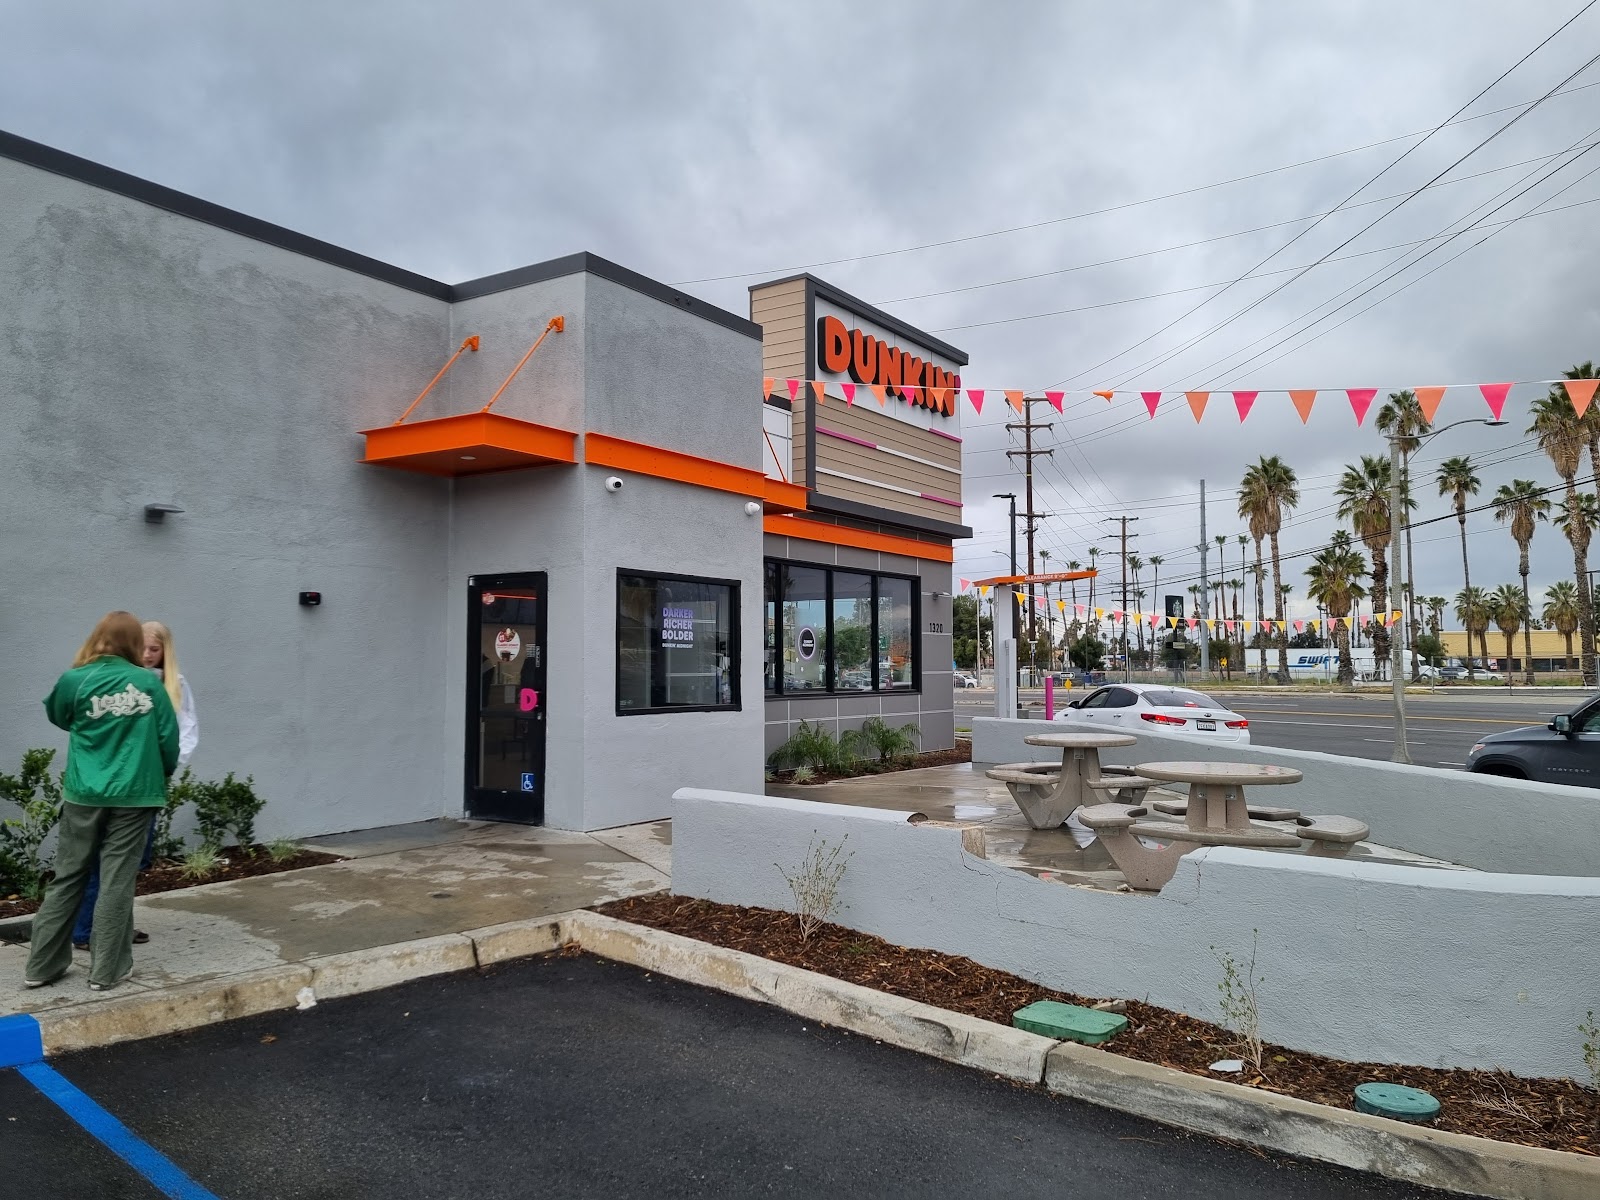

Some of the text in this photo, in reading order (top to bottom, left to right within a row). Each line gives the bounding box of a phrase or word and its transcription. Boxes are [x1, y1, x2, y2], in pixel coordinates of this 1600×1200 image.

[662, 607, 693, 618] DARKER
[663, 618, 693, 630] RICHER
[929, 622, 944, 633] 1320
[662, 630, 694, 641] BOLDER
[520, 688, 538, 711] D
